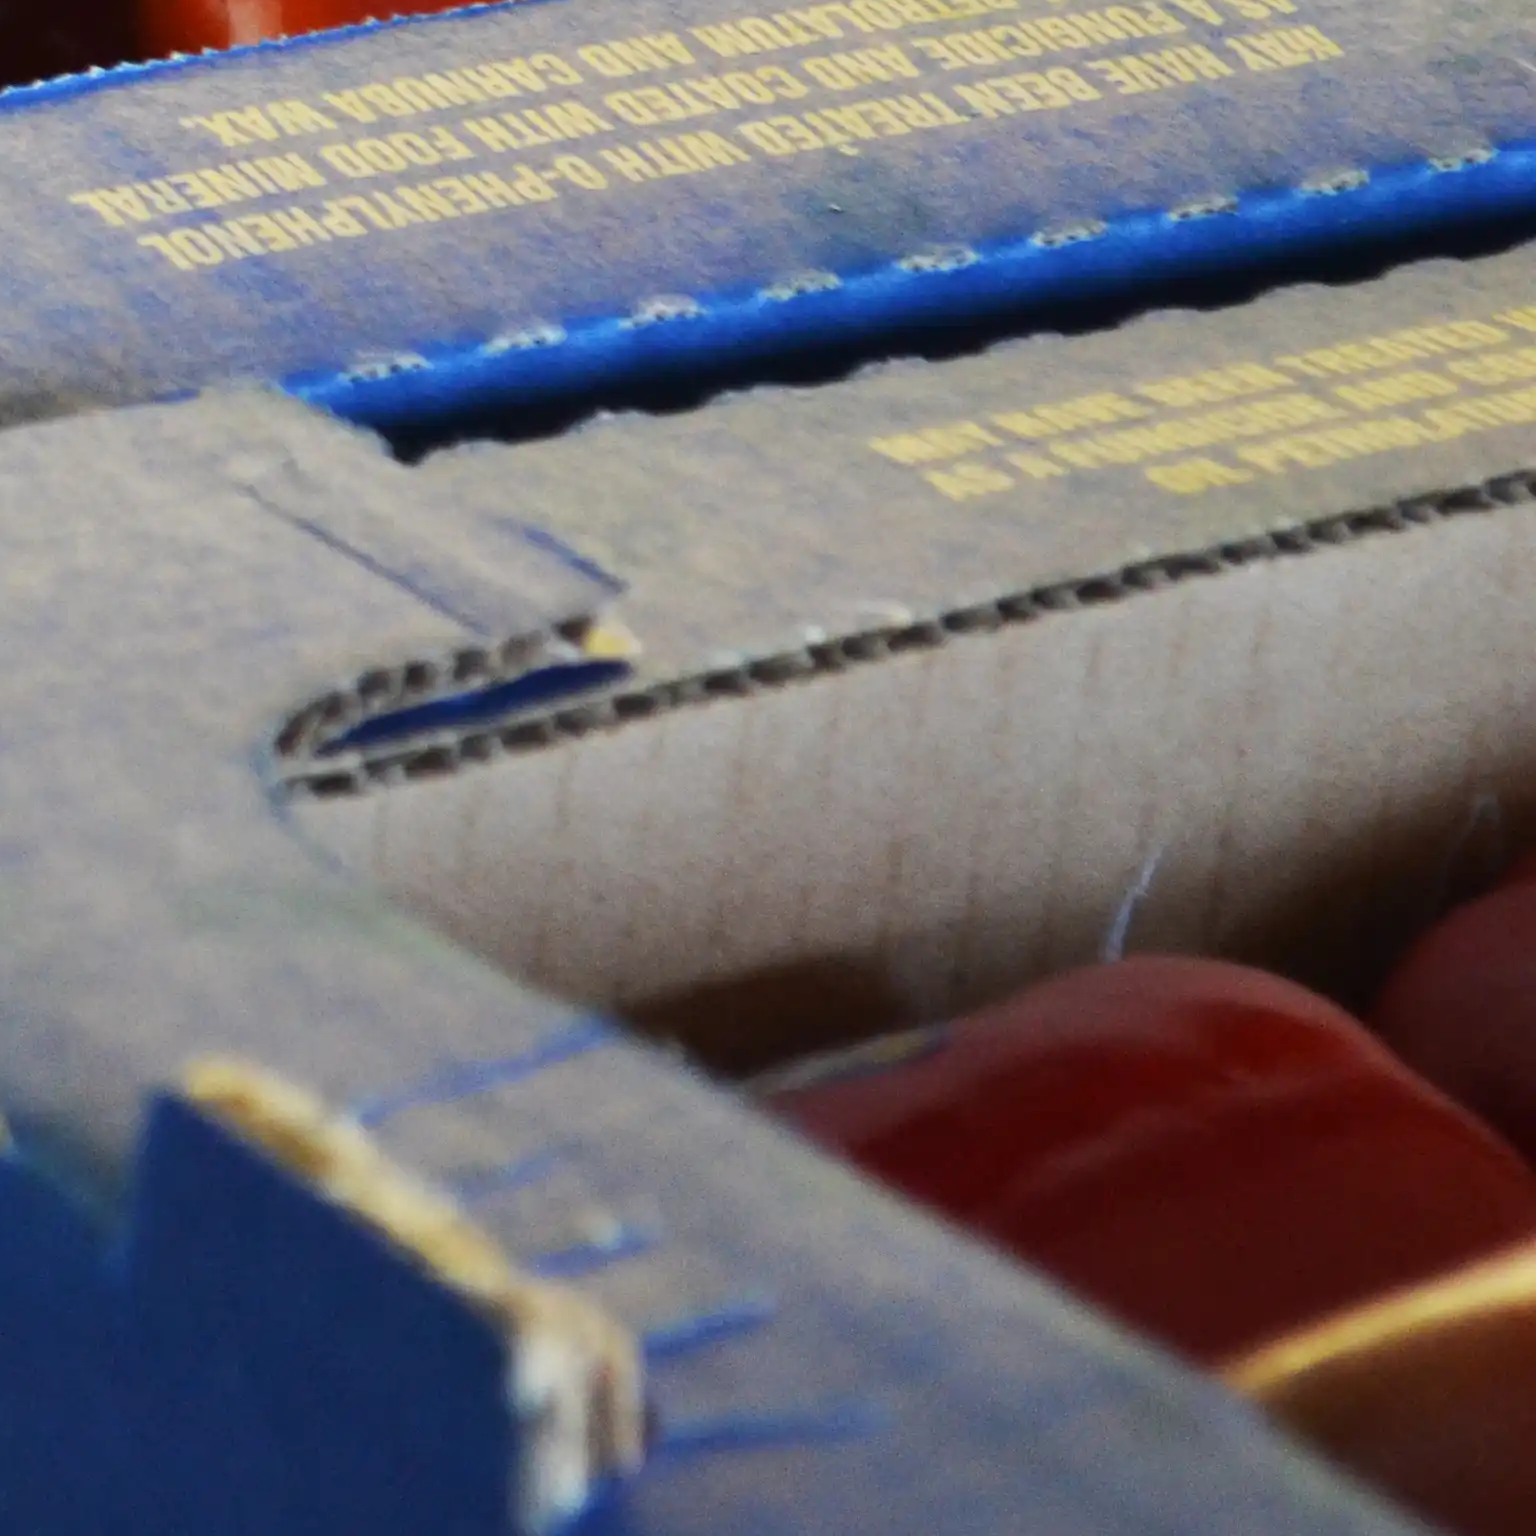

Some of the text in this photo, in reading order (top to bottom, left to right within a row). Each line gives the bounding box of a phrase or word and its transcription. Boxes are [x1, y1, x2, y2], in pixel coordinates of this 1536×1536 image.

[578, 31, 696, 77] AND
[911, 1, 1187, 70] FUNGICIDE
[323, 53, 584, 124] CARNUBA
[801, 42, 920, 91] AND
[179, 99, 337, 147] WAX.
[604, 67, 809, 125] COATED
[137, 24, 1345, 271] MAY HAVE BEEN TREATED WITH O-PHENYLPHENOL
[321, 126, 475, 178] FOOD
[463, 101, 615, 153] WITH
[69, 152, 328, 227] MINERAL
